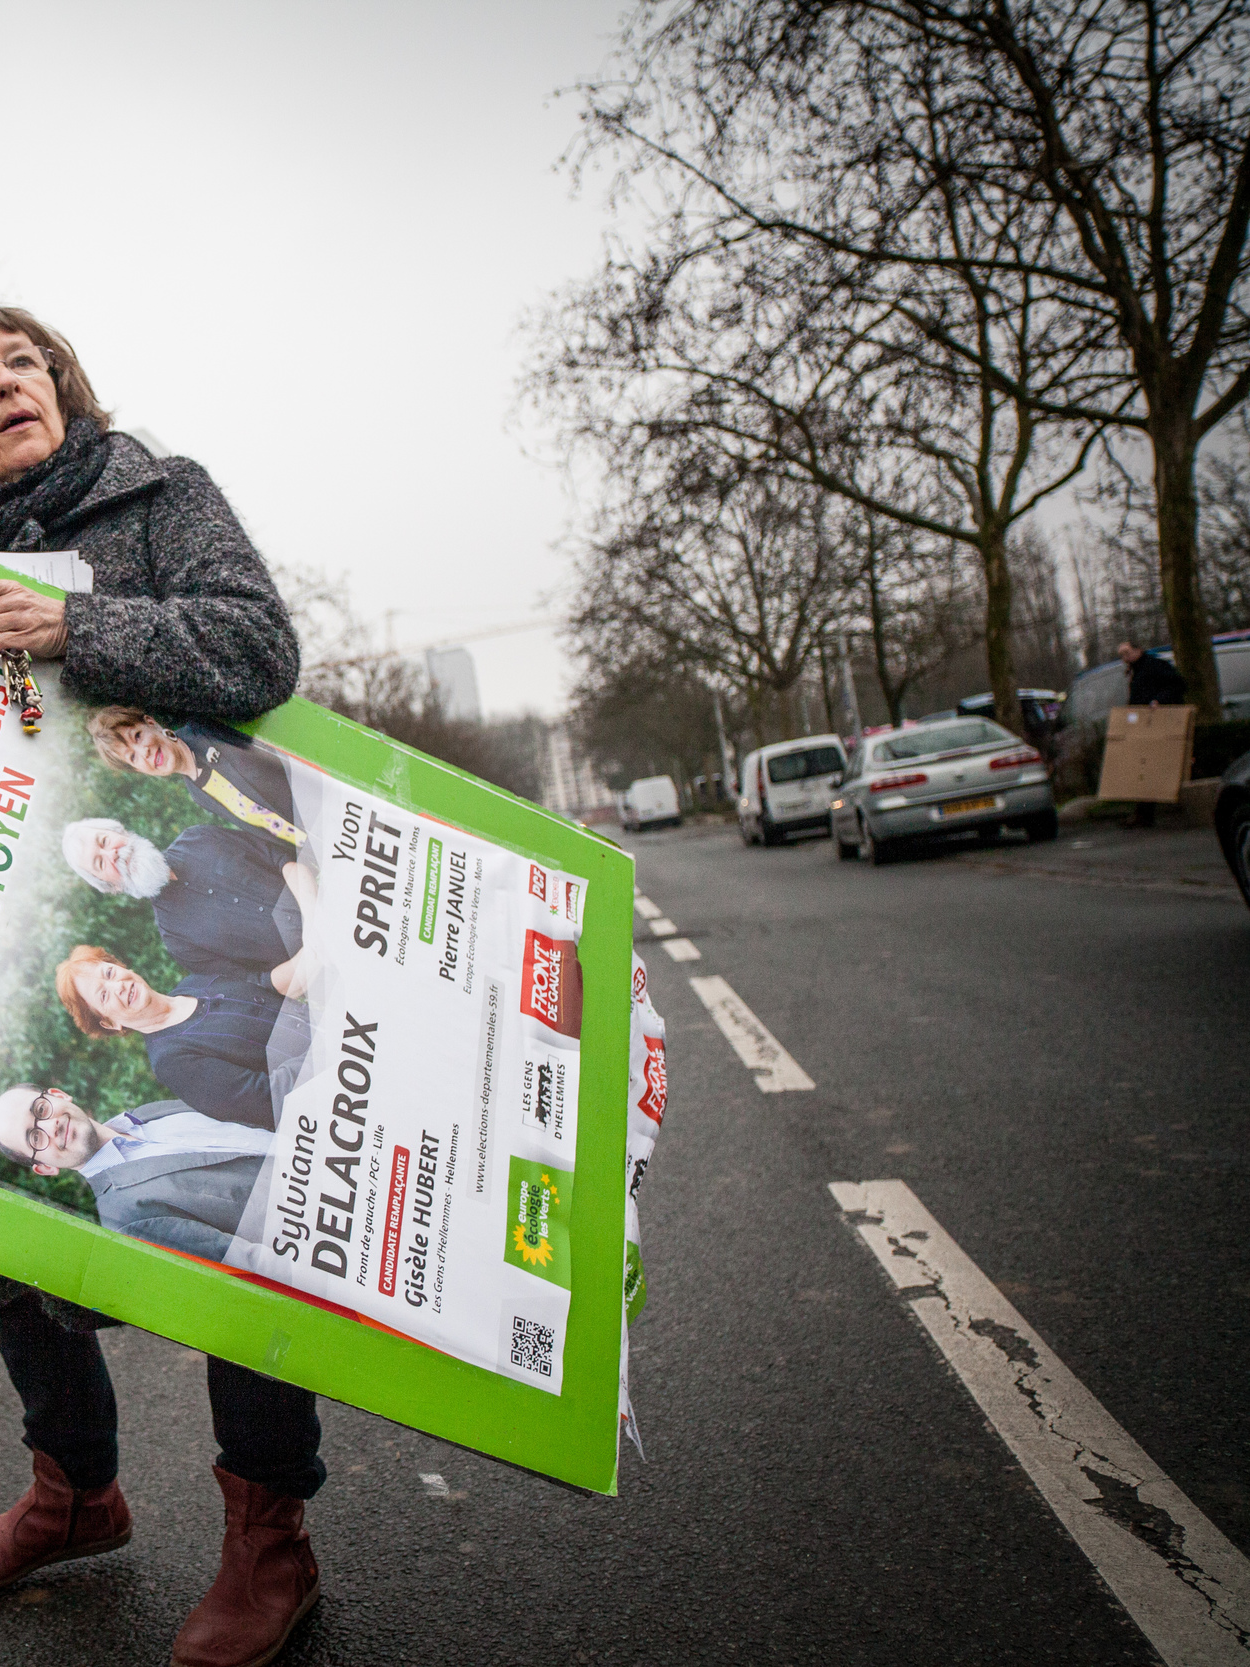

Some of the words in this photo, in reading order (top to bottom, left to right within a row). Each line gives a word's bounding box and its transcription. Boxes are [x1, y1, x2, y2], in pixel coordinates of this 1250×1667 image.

[409, 826, 420, 852] Mons
[354, 811, 401, 957] SPRIET
[404, 859, 415, 897] Maurice
[428, 842, 443, 895] REMPLAÇANT
[446, 852, 466, 923] JANUEL
[474, 858, 482, 881] Mons
[533, 869, 546, 898] PCF
[403, 898, 411, 909] St
[423, 895, 435, 938] CANDIDAT
[469, 910, 478, 923] les
[471, 887, 481, 908] Verts
[395, 916, 409, 966] Écologiste
[439, 923, 459, 981] Pierre
[466, 924, 478, 961] Ecologie
[463, 962, 475, 994] Europe
[532, 940, 551, 1015] FRONT
[546, 948, 562, 1002] GAUCHE
[547, 1001, 557, 1022] DE
[476, 985, 498, 1192] www.elections-departementales-59.fr
[524, 1061, 533, 1089] GENS
[523, 1093, 531, 1111] LES
[554, 1064, 565, 1140] D'HELLEMMES
[311, 1011, 378, 1279] DELACROIX
[373, 1125, 384, 1149] Lille
[445, 1124, 459, 1185] Hellemmes
[369, 1156, 379, 1180] PCF
[413, 1129, 439, 1227] HUBERT
[273, 1115, 317, 1262] Sylviane
[517, 1181, 529, 1223] europe
[539, 1188, 550, 1220] Verts
[365, 1189, 376, 1234] gauche
[383, 1230, 397, 1290] CANDIDATE
[390, 1154, 406, 1229] REMPLAÇANTE
[437, 1193, 451, 1263] d'Hellemmes
[524, 1184, 540, 1245] écologie
[538, 1221, 549, 1237] les
[361, 1235, 370, 1250] de
[357, 1252, 369, 1286] Front
[405, 1234, 428, 1307] Gisèle
[434, 1265, 444, 1292] Gens
[432, 1295, 441, 1314] Les
